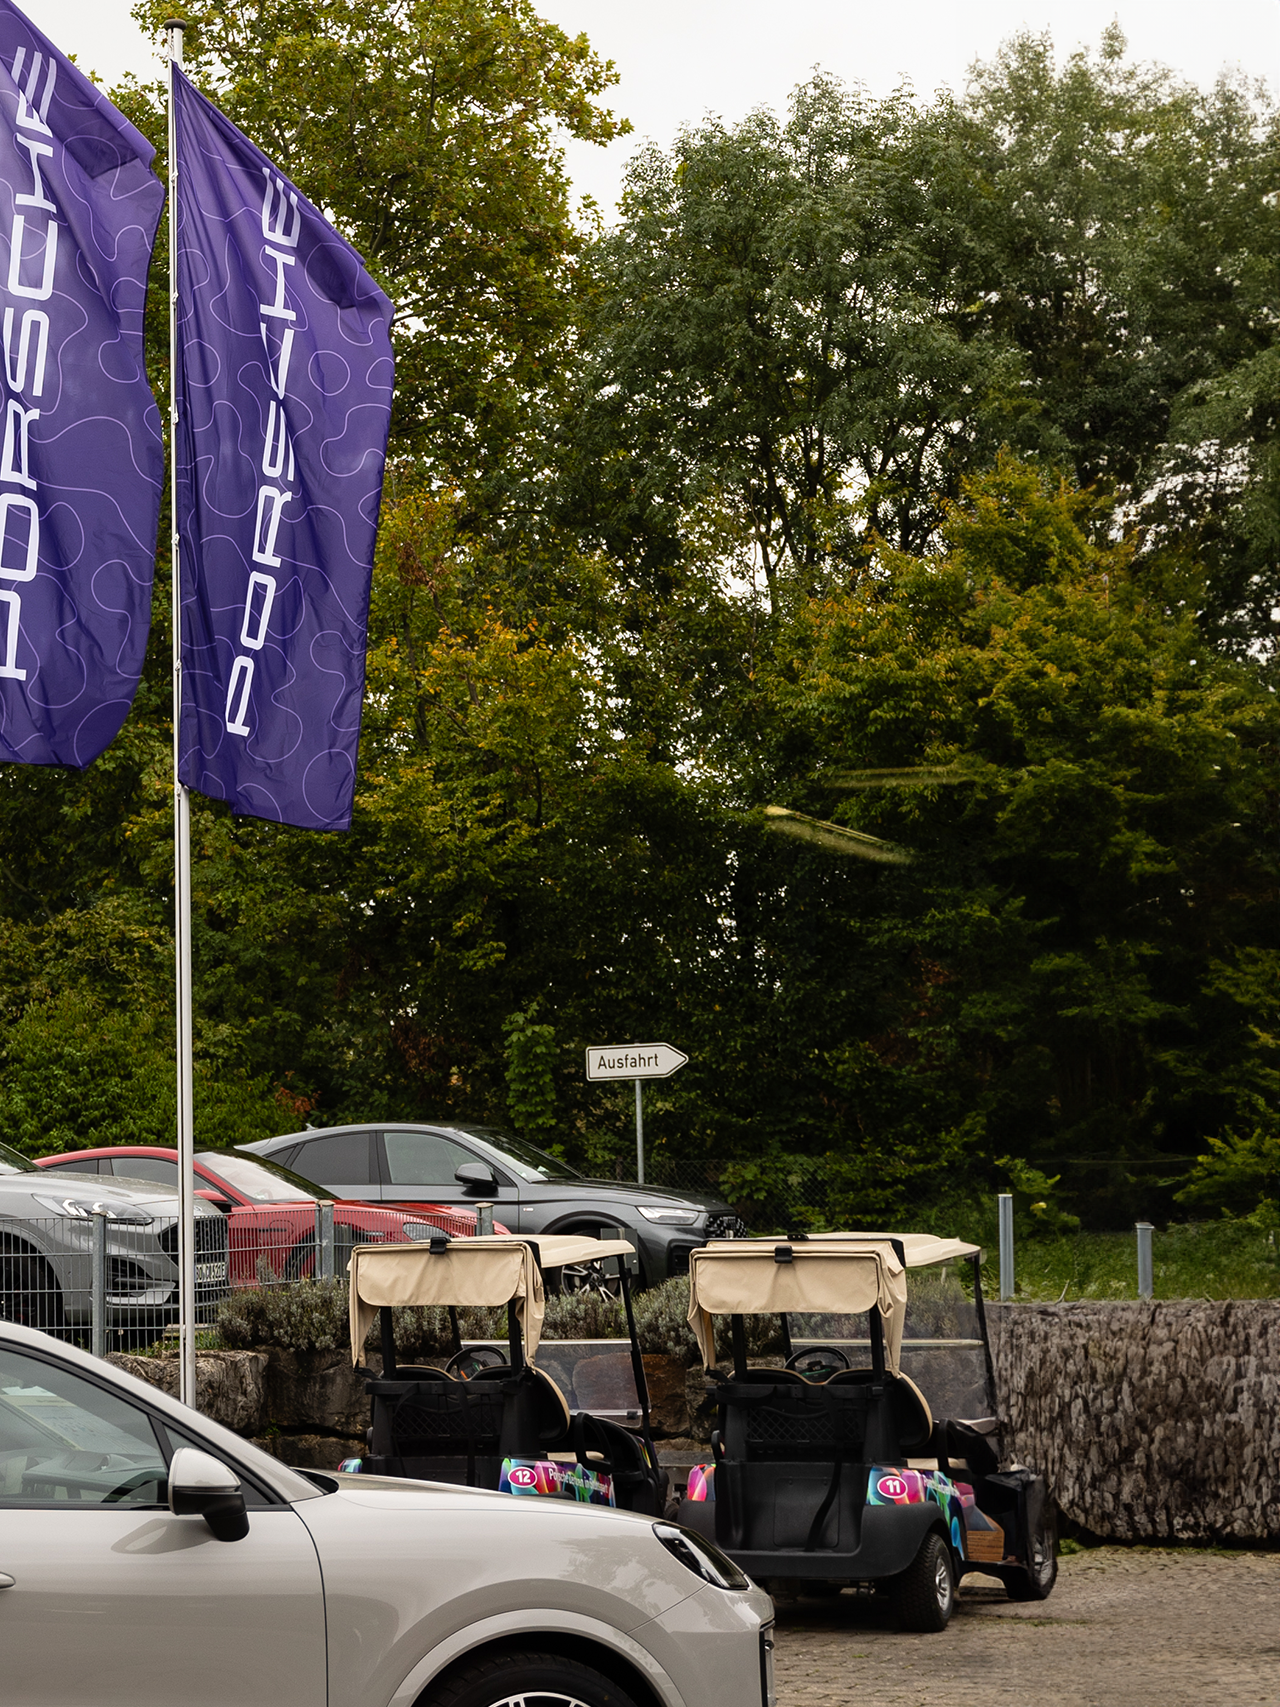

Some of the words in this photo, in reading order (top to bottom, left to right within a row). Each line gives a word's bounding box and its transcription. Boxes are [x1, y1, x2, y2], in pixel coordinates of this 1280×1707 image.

[225, 167, 301, 737] PORSCHE
[597, 1053, 659, 1070] Ausfahrt
[516, 1471, 531, 1483] 12
[886, 1480, 900, 1493] 11
